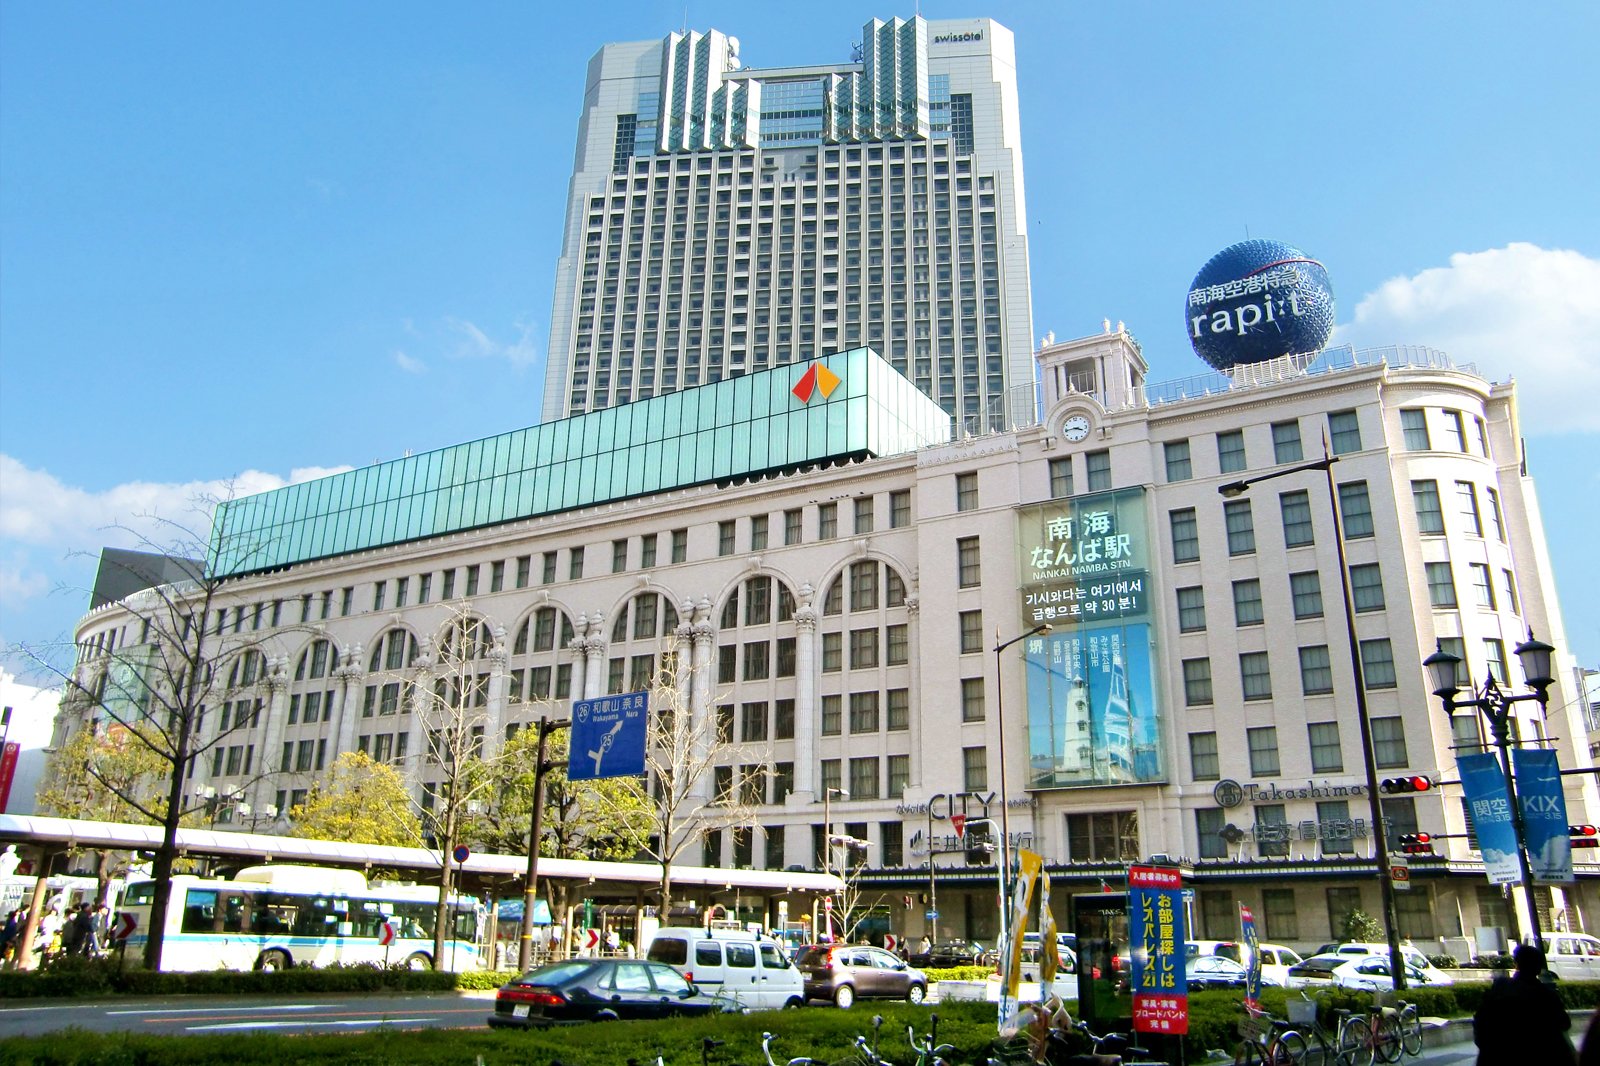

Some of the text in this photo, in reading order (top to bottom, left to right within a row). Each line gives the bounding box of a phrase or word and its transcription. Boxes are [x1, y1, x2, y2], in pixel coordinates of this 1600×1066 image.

[1188, 270, 1299, 307] 南海空港特急
[1030, 533, 1132, 569] なんば駅
[1032, 568, 1070, 581] NANKAI
[1071, 563, 1109, 575] NAMBA
[1025, 578, 1142, 606] 기시와다는 여기에서
[1031, 596, 1137, 621] 급행으로 약 30 분!
[580, 706, 588, 717] 26
[592, 695, 644, 714] 和歌山 奈良
[593, 714, 619, 722] Wakayama
[603, 735, 611, 746] 25
[1243, 780, 1390, 801] Takashimaa
[929, 791, 996, 820] CITY
[1473, 798, 1509, 817] 関空
[1522, 795, 1560, 813] KIX
[1495, 814, 1511, 823] 3.15
[1544, 812, 1562, 820] 3.15
[1157, 893, 1175, 988] お部屋探しは
[1135, 1009, 1186, 1020] ブロードバンド
